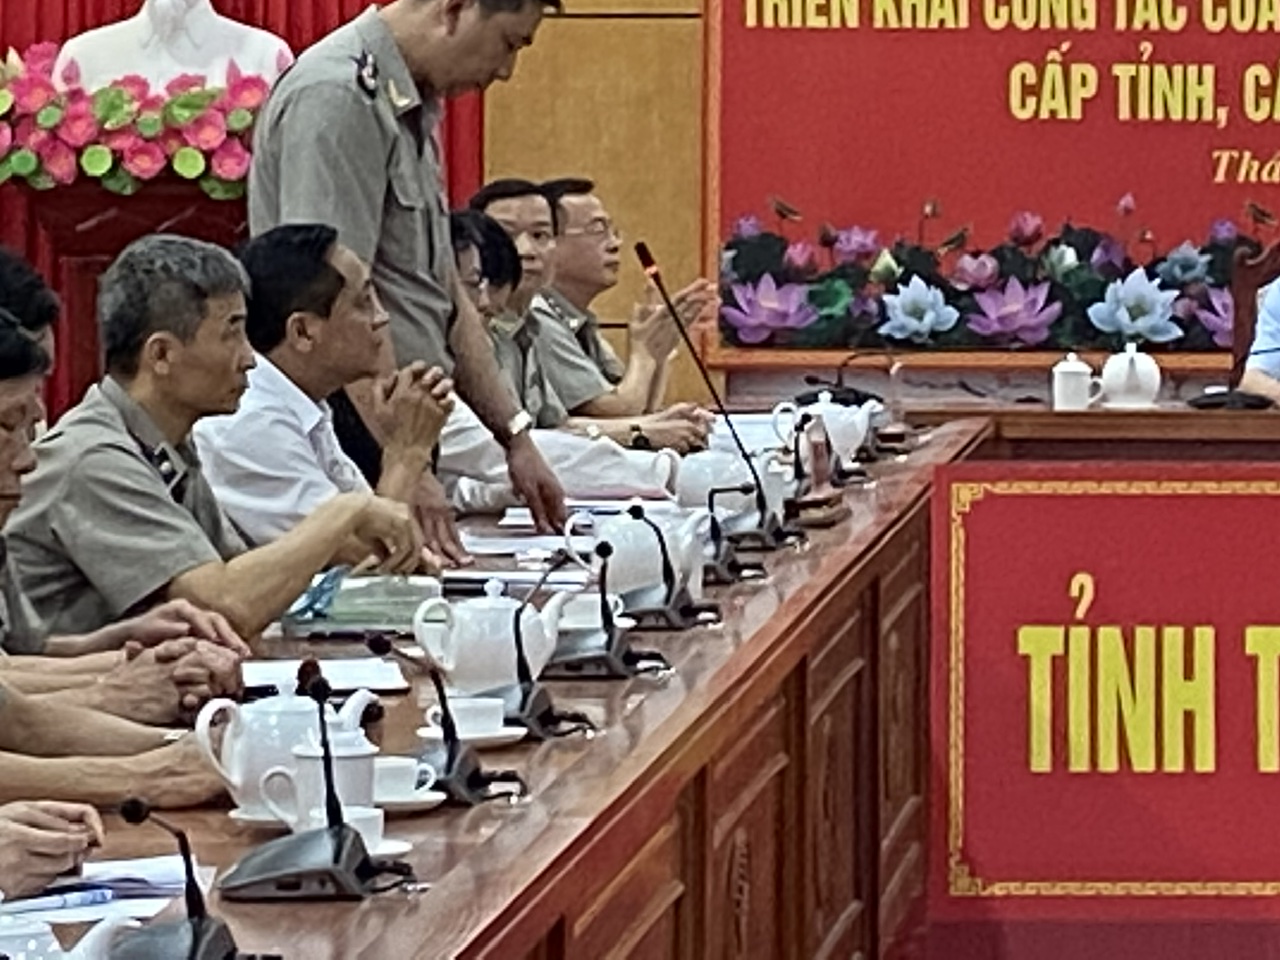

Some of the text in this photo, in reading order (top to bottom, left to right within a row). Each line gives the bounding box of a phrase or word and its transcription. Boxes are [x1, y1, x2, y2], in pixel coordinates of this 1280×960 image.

[1008, 41, 1098, 121] CẤP
[1111, 41, 1229, 128] TỈNH,
[1018, 573, 1216, 774] TỈNH
